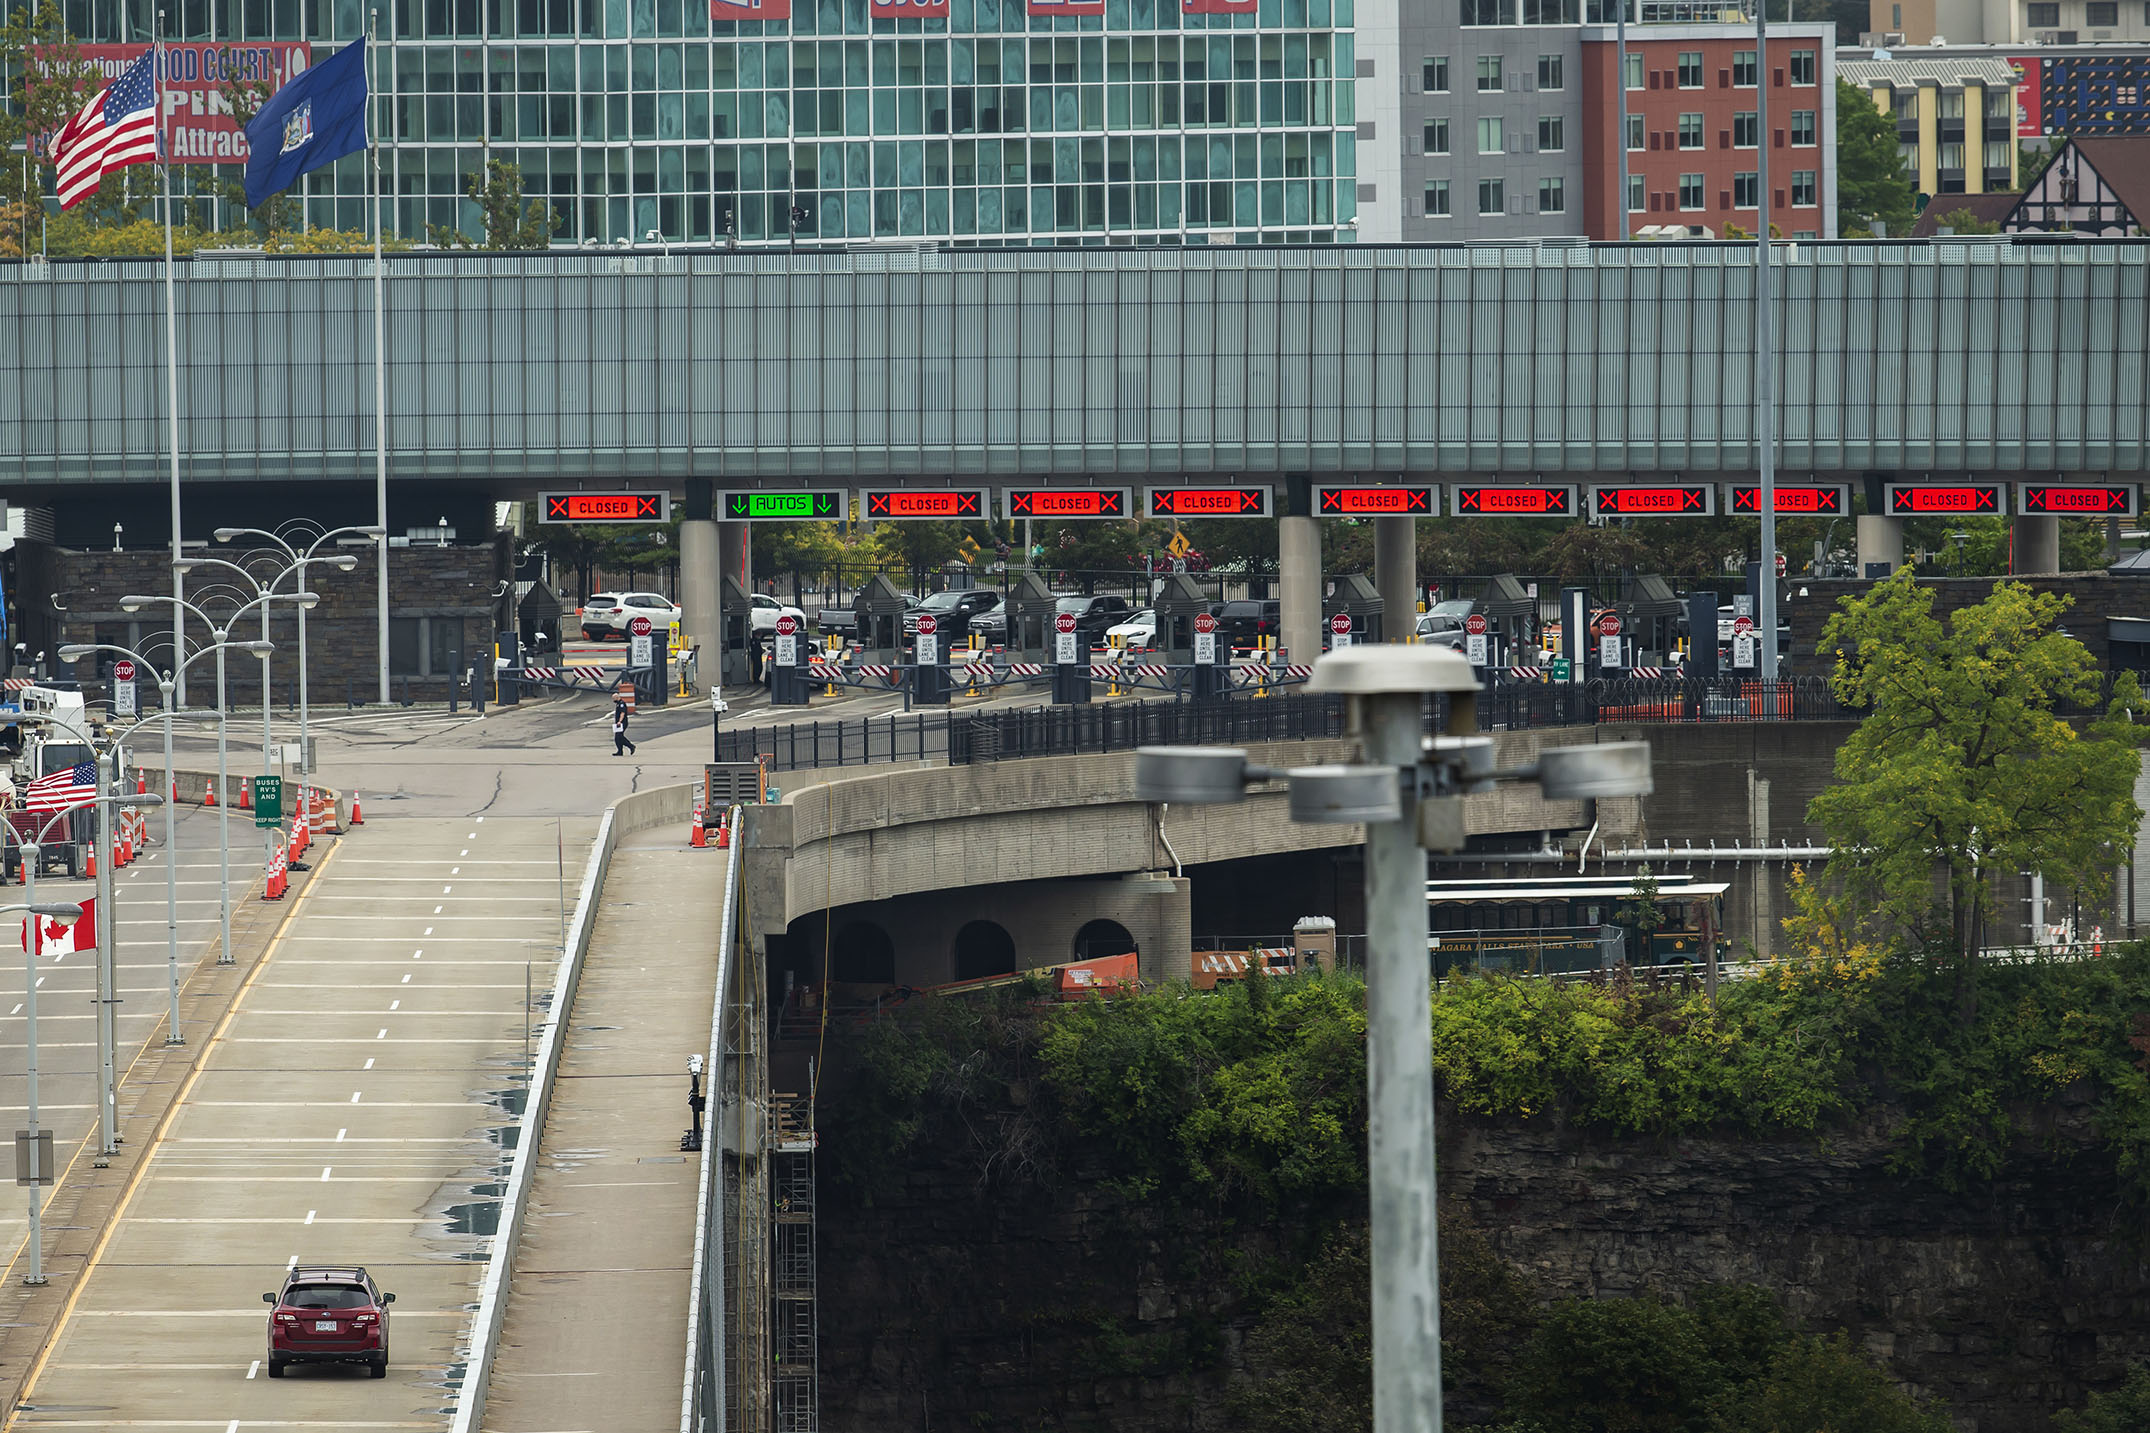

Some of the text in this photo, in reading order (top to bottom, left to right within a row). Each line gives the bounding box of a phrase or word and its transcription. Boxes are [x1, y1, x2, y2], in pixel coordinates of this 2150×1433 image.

[156, 47, 198, 83] OOD
[203, 47, 272, 83] COURT
[173, 126, 252, 158] Attrac
[756, 497, 806, 510] AUTOS
[900, 499, 948, 510] CLOSED
[1043, 499, 1090, 509] CLOSED
[1184, 497, 1231, 508] CLOSED
[1352, 496, 1398, 506] CLOSED
[1490, 496, 1537, 506] CLOSED
[1628, 496, 1674, 506] CLOSED
[1923, 495, 1967, 505] CLOSED
[2055, 495, 2099, 506] CLOSED
[580, 503, 628, 513] CLOSED
[633, 622, 651, 631] STOP
[777, 622, 795, 630] STOP
[918, 621, 935, 629] STOP
[1057, 619, 1075, 628] STOP
[1196, 620, 1213, 628] STOP
[1333, 620, 1350, 628] STOP
[1468, 621, 1485, 629] STOP
[1601, 622, 1619, 630] STOP
[1735, 623, 1753, 631] STOP
[116, 666, 133, 675] STOP
